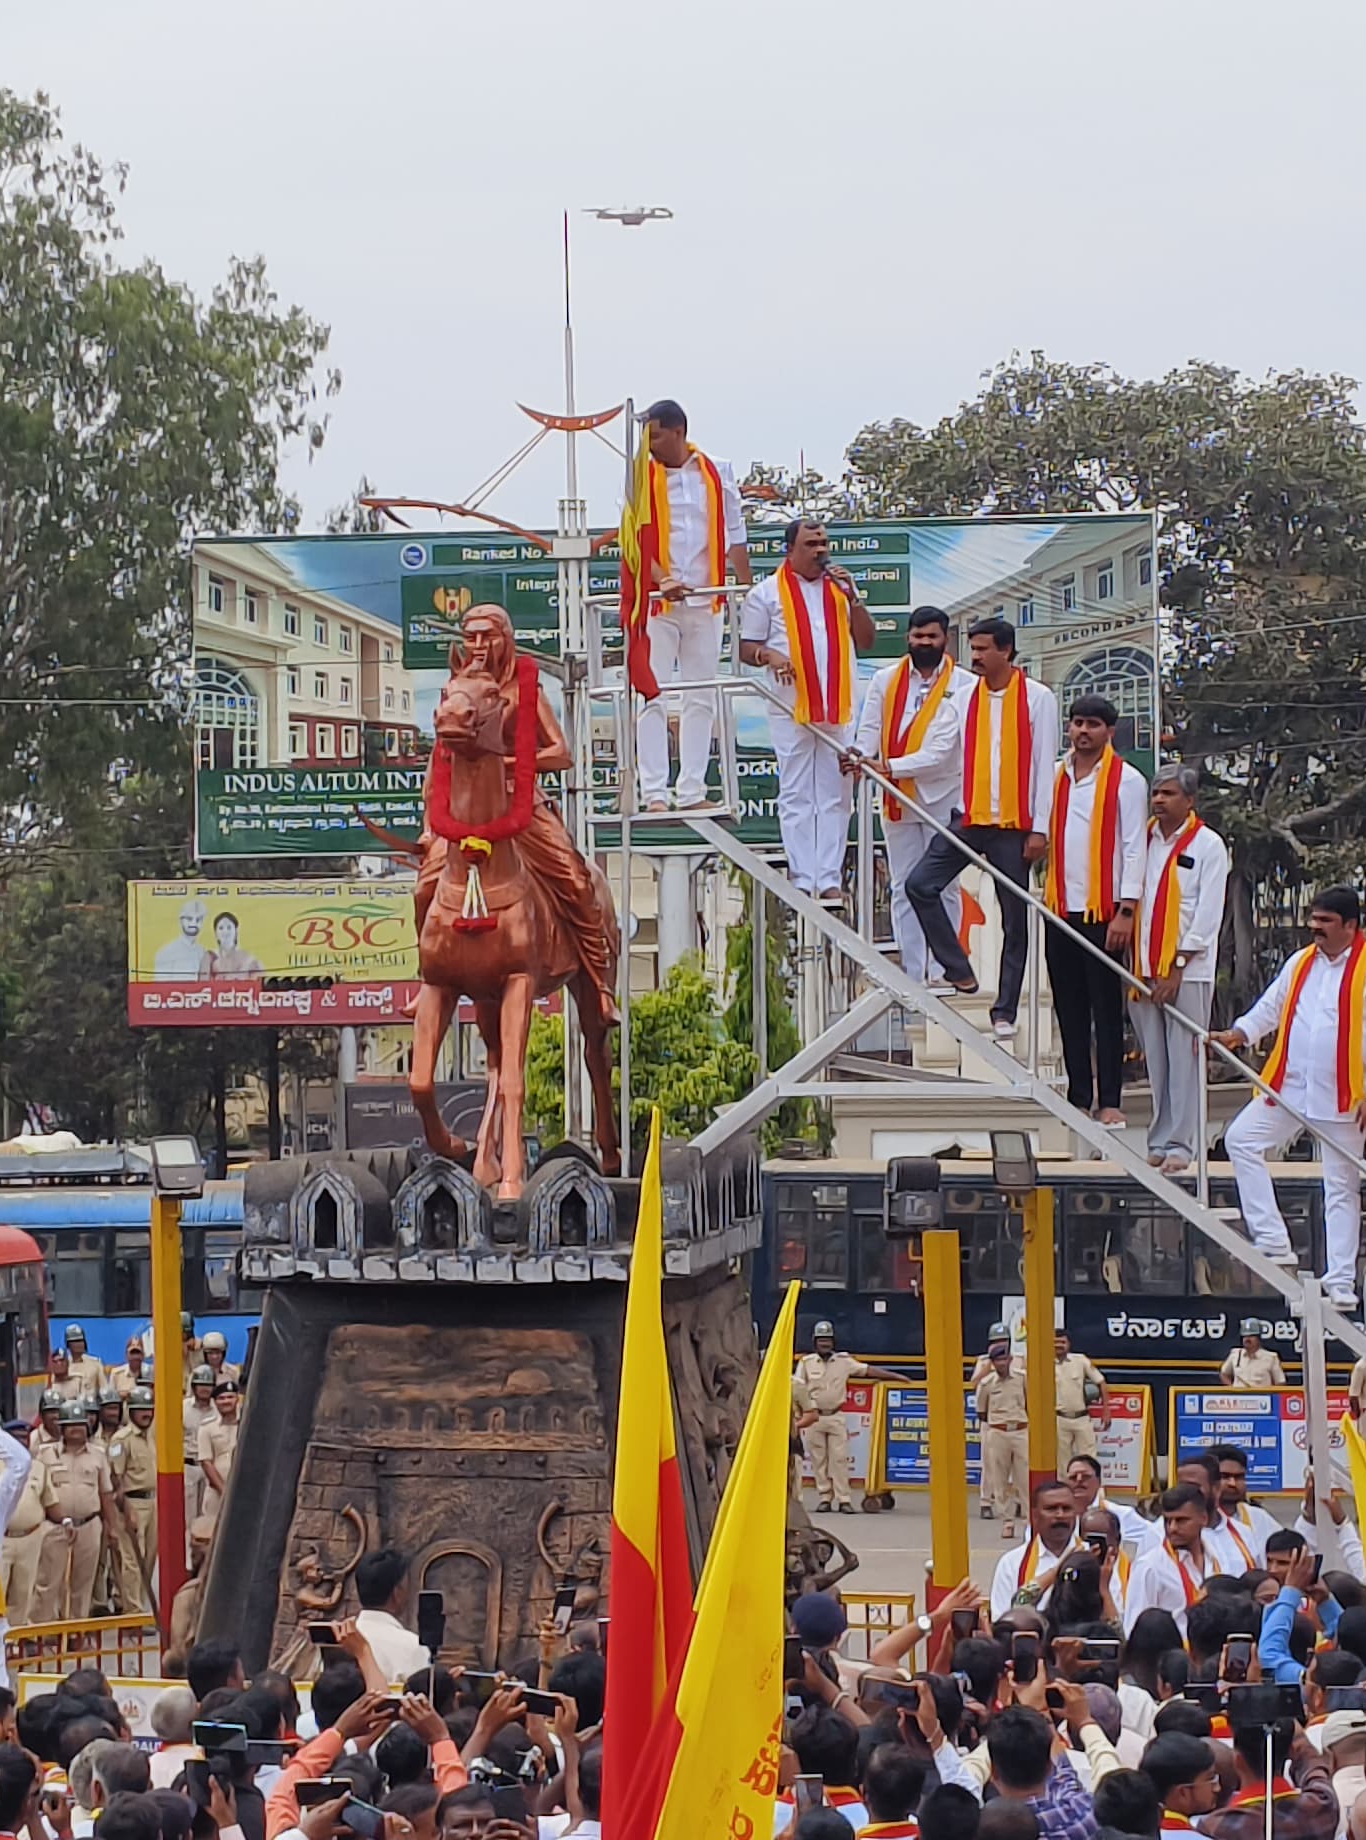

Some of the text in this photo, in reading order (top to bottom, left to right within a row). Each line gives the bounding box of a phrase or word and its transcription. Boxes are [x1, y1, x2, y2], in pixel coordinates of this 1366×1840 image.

[462, 548, 517, 561] Ranked
[224, 773, 295, 793] INDUS
[300, 771, 380, 792] ALTUM
[287, 916, 405, 951] BSC
[1107, 1312, 1227, 1339] ಕರ್ನಾಟಕ
